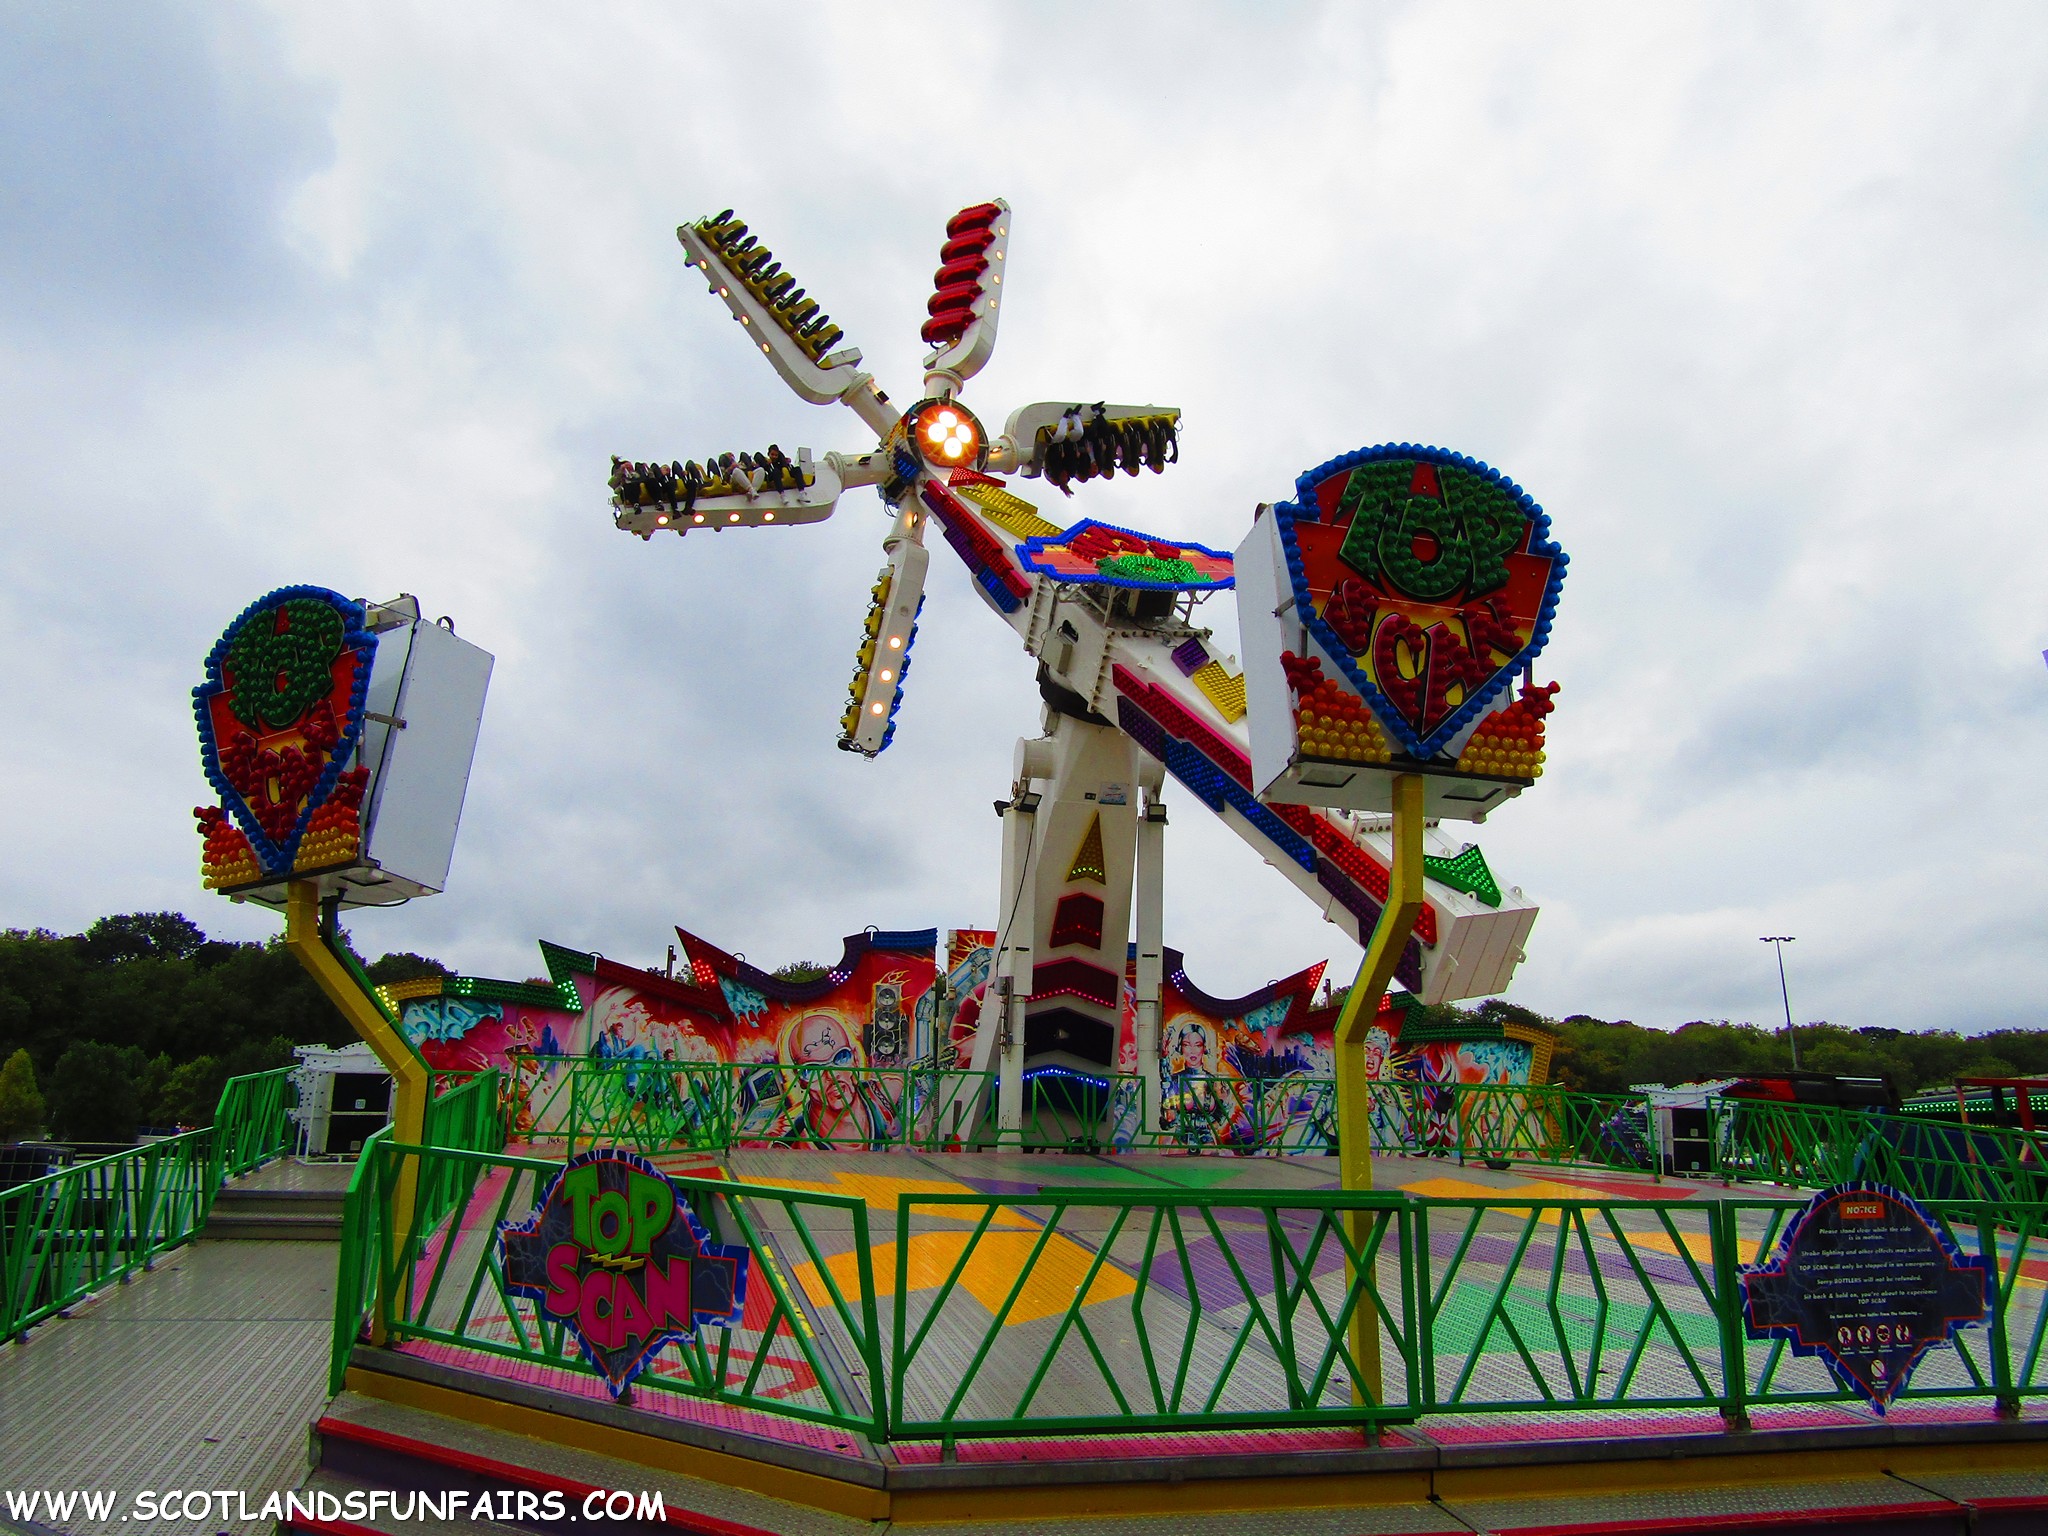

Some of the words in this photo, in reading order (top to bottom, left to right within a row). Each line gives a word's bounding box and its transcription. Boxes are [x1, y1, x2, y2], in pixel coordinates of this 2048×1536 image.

[1332, 458, 1527, 600] TOP
[226, 598, 346, 732] TOP
[1321, 577, 1525, 736] SCAN
[219, 699, 341, 845] SCAN
[563, 1163, 676, 1254] TOP
[1821, 1249, 1844, 1257] lighting
[1846, 1206, 1877, 1214] NOTICE
[543, 1242, 692, 1353] SCAN
